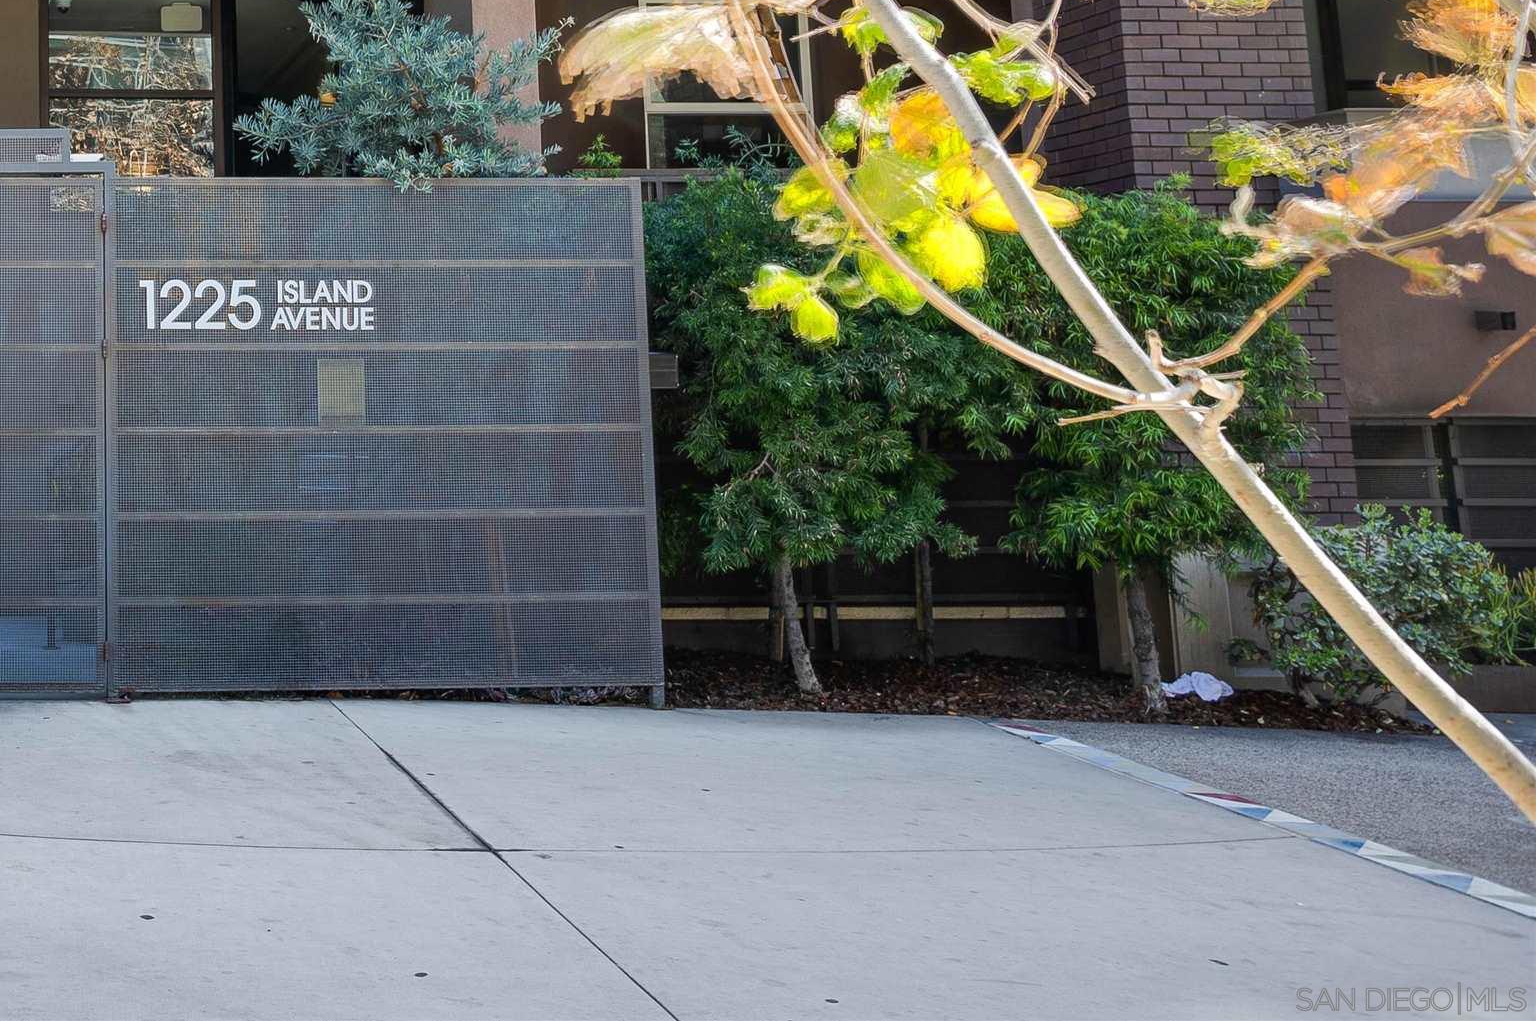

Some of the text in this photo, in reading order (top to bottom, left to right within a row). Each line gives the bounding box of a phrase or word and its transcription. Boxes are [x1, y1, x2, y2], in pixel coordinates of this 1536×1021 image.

[277, 280, 373, 304] ISLAND
[139, 280, 262, 330] 1225
[270, 306, 374, 330] AVENUE
